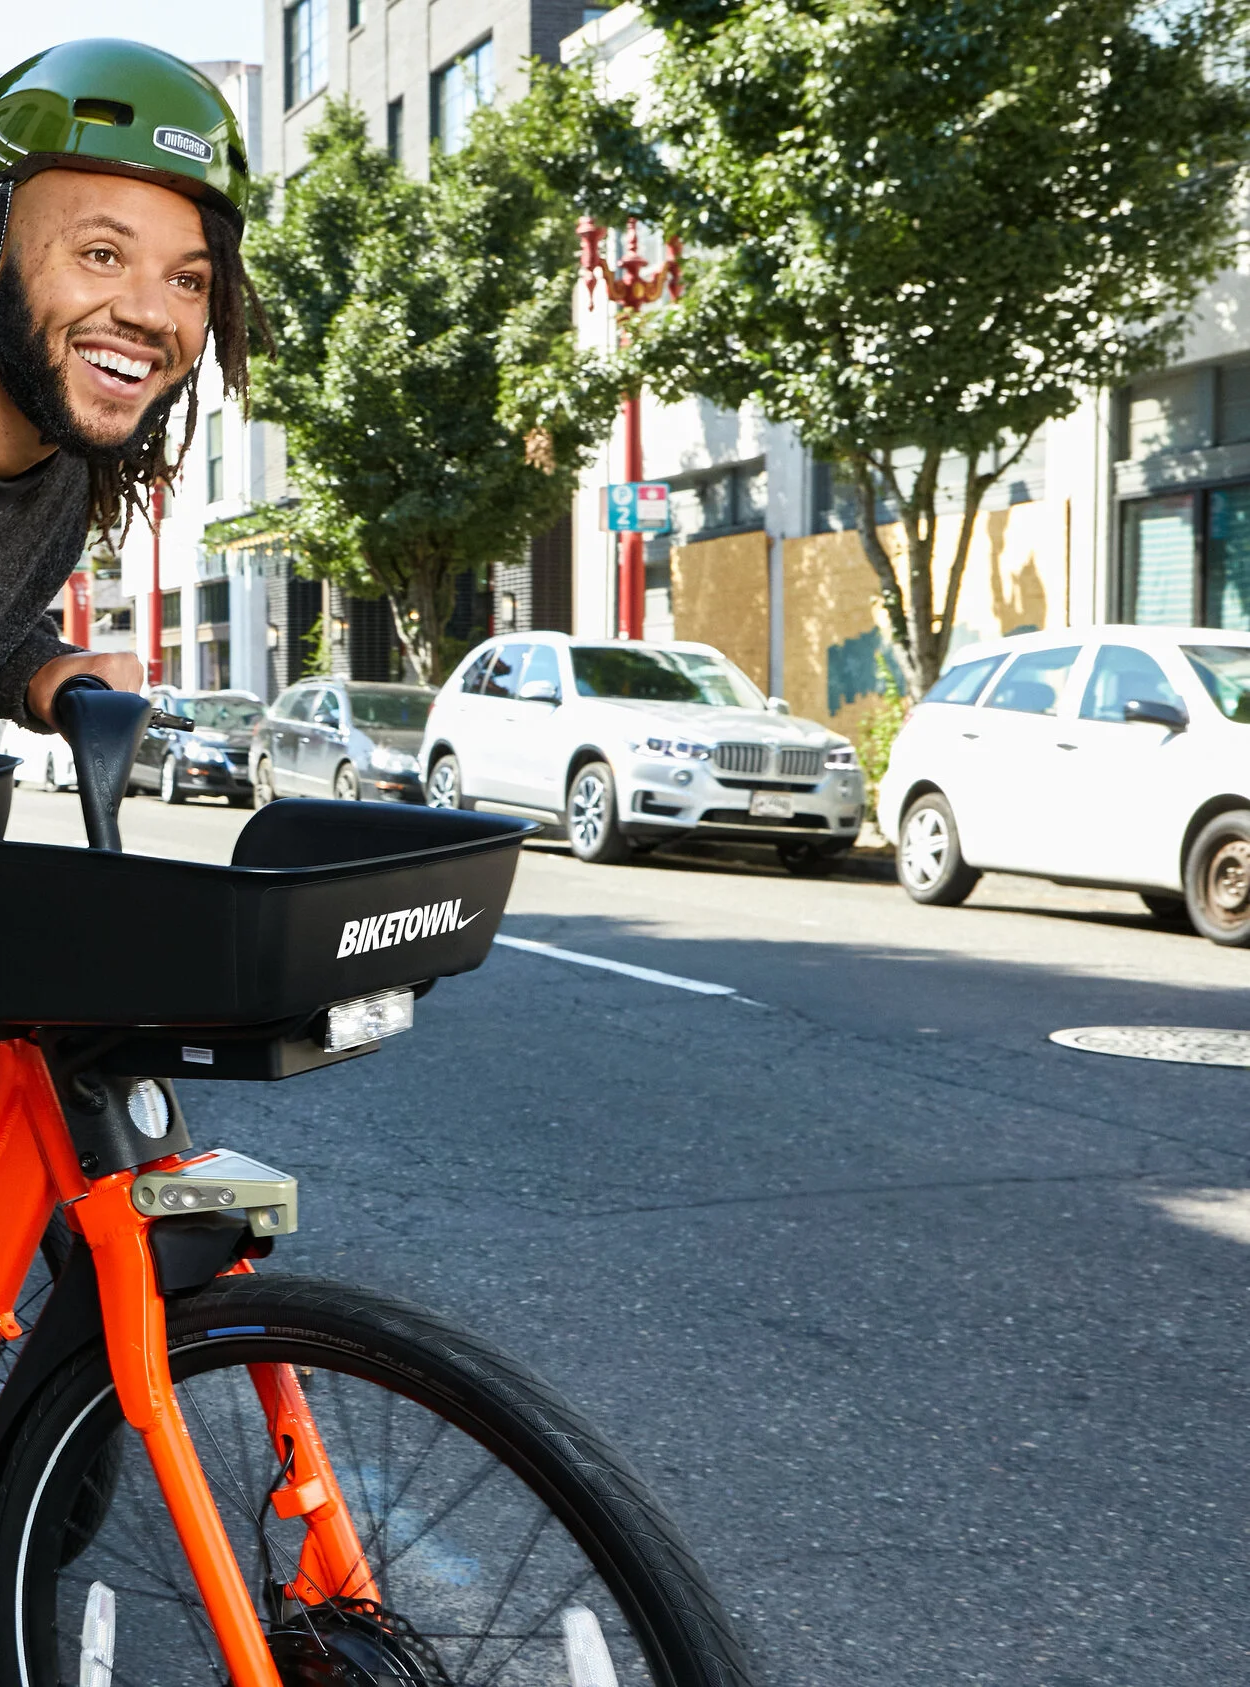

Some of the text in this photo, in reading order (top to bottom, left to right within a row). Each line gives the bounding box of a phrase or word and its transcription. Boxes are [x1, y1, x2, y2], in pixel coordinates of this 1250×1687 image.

[164, 132, 206, 156] nutcase
[616, 506, 631, 525] 2
[336, 898, 463, 960] BIKETOWN
